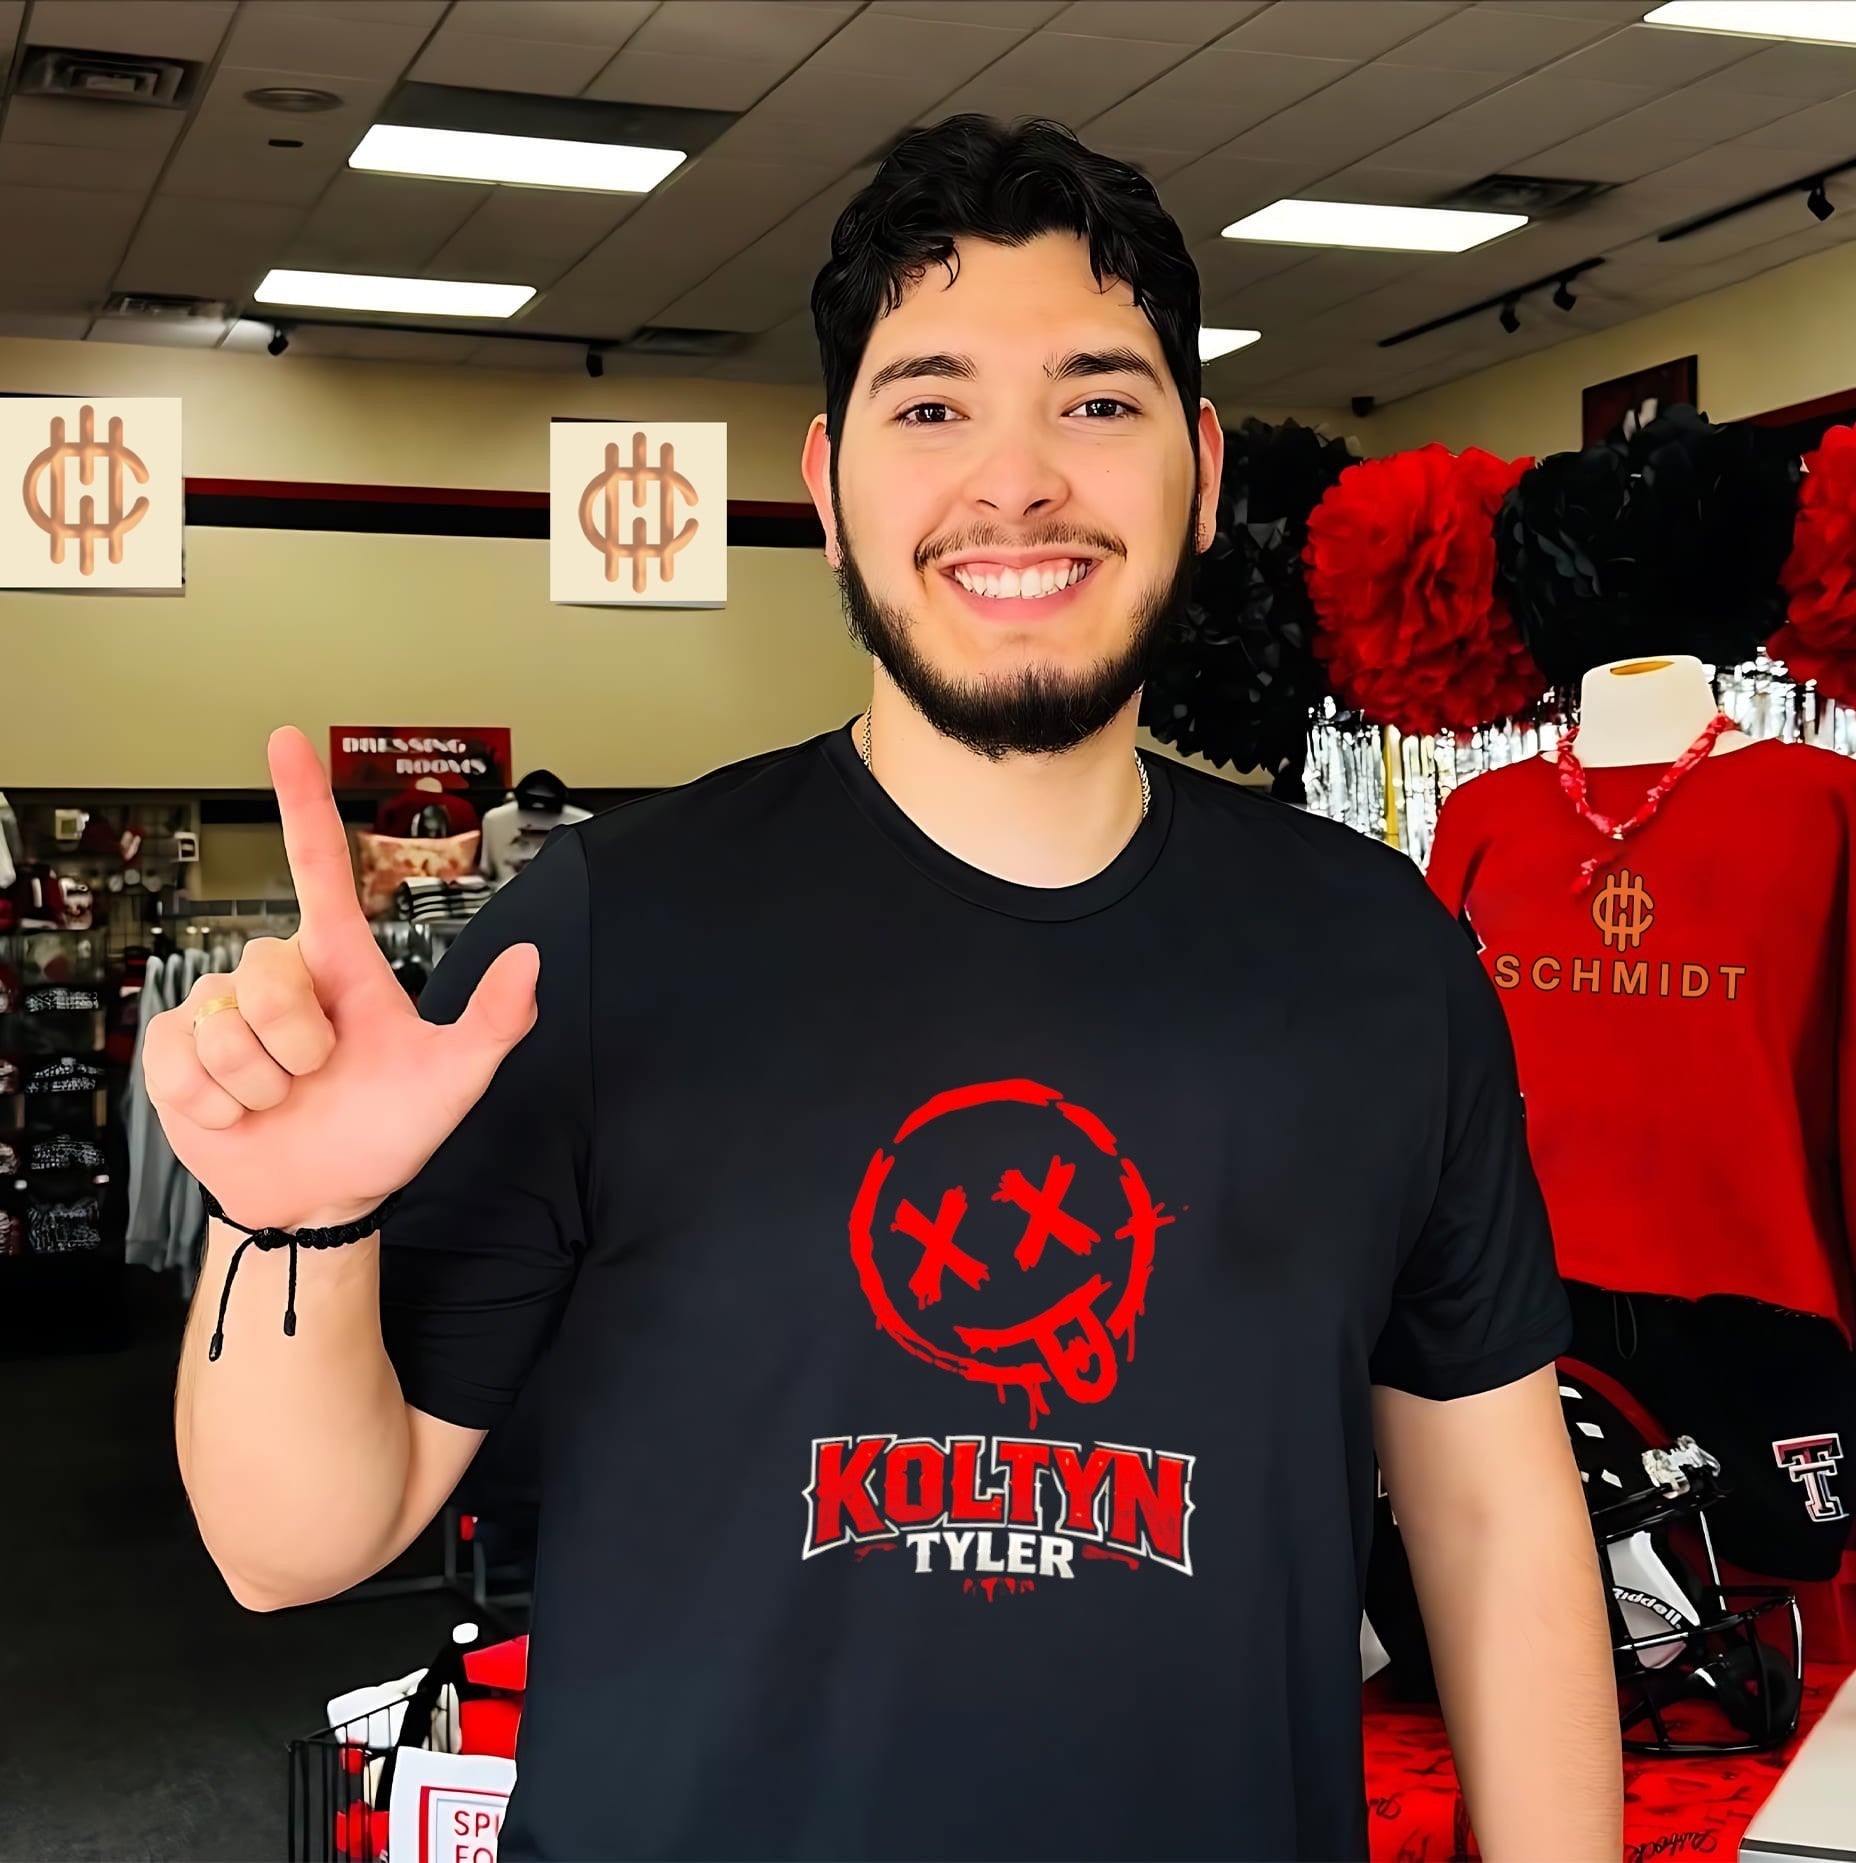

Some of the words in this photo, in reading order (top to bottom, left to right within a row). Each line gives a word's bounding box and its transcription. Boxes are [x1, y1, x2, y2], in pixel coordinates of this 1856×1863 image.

[341, 737, 467, 754] DRESSING
[396, 758, 487, 775] ROOMS
[1493, 952, 1747, 1001] SCHMIDT
[801, 1434, 1197, 1576] KOLTYN
[906, 1531, 1075, 1579] TYLER
